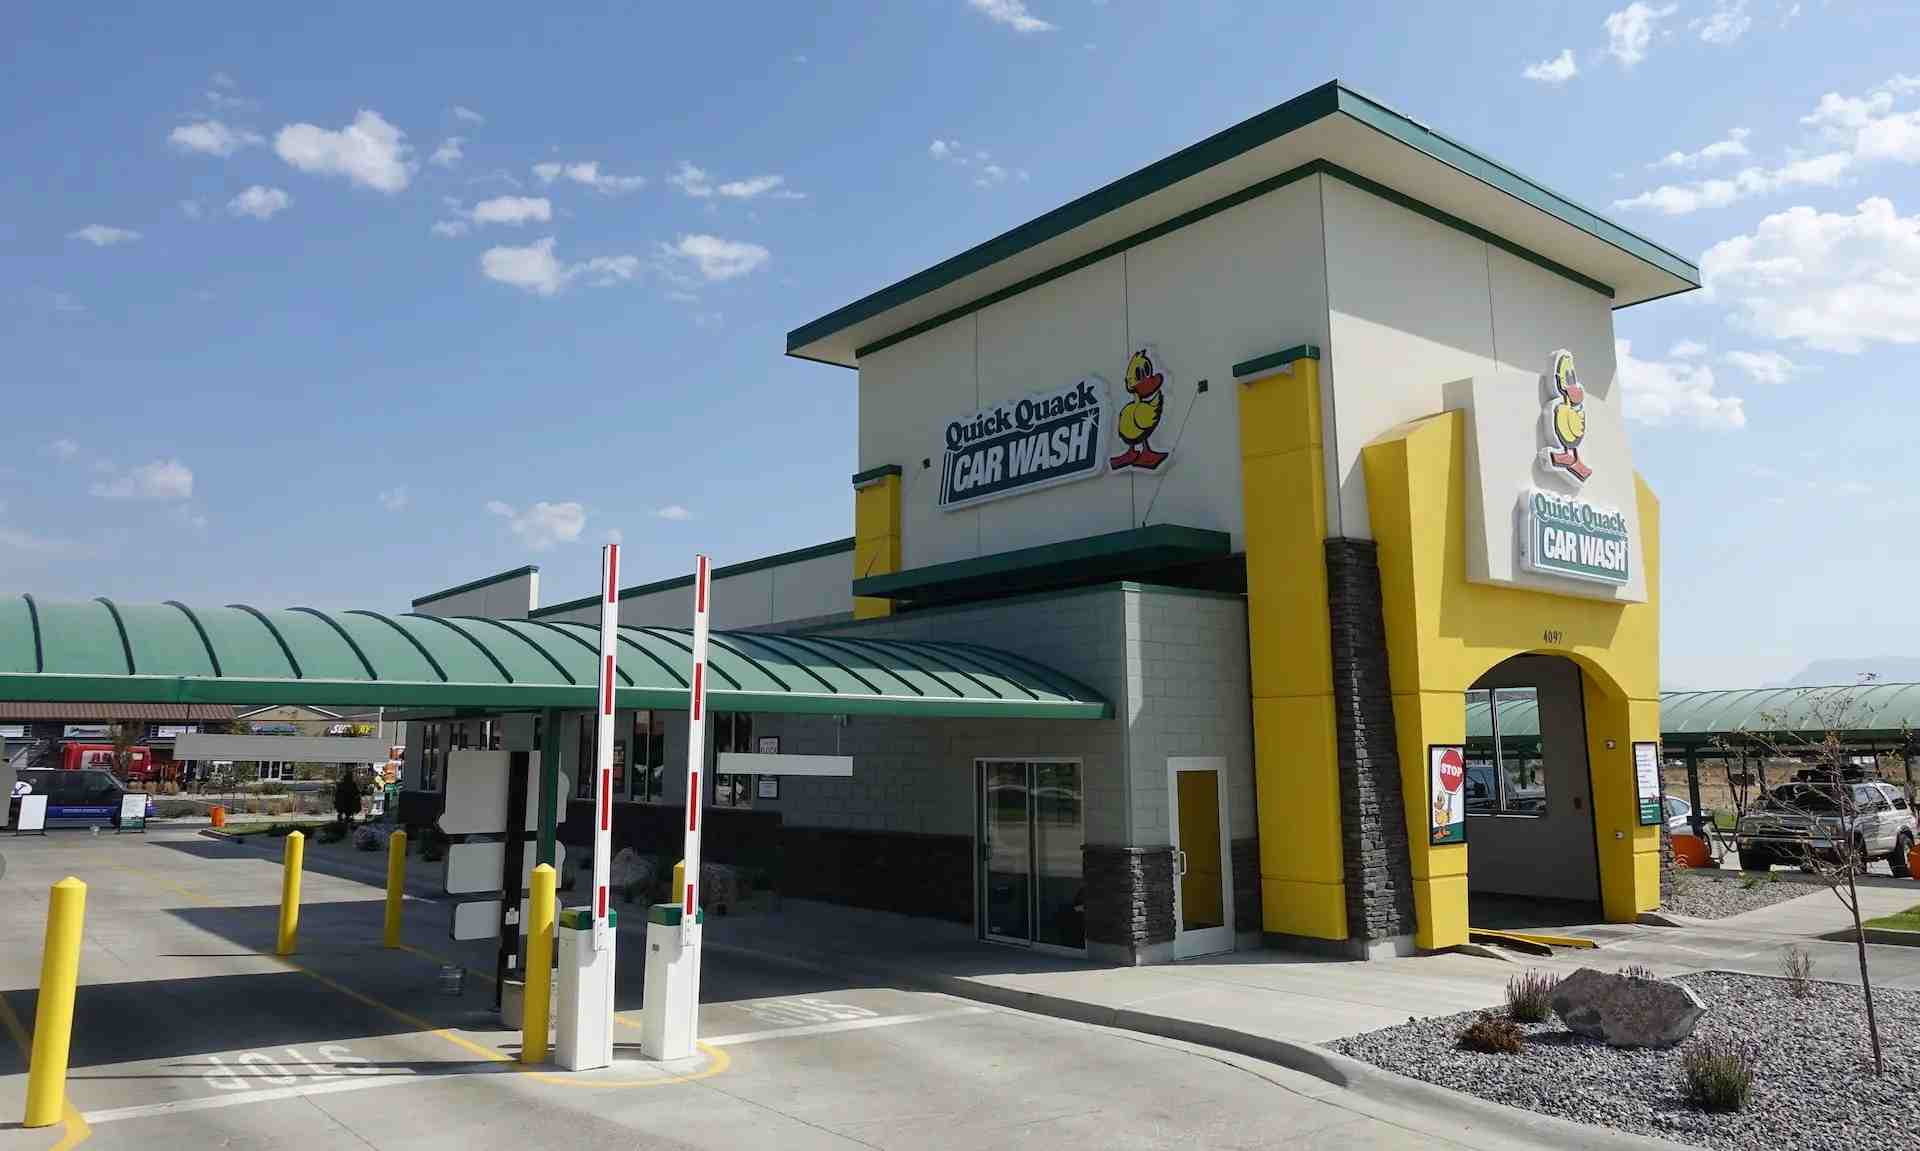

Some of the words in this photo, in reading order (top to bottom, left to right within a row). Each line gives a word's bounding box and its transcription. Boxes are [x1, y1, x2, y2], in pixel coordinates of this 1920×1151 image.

[946, 406, 1013, 449] Quick
[1015, 381, 1098, 428] Quack
[953, 449, 1003, 493] CAR
[1008, 422, 1090, 477] WASH
[1535, 493, 1580, 521] Quick
[1581, 504, 1627, 533] Quack
[1543, 527, 1577, 563] CAR
[1579, 534, 1627, 571] WASH
[1441, 763, 1462, 777] STOP
[204, 1045, 380, 1090] STOP
